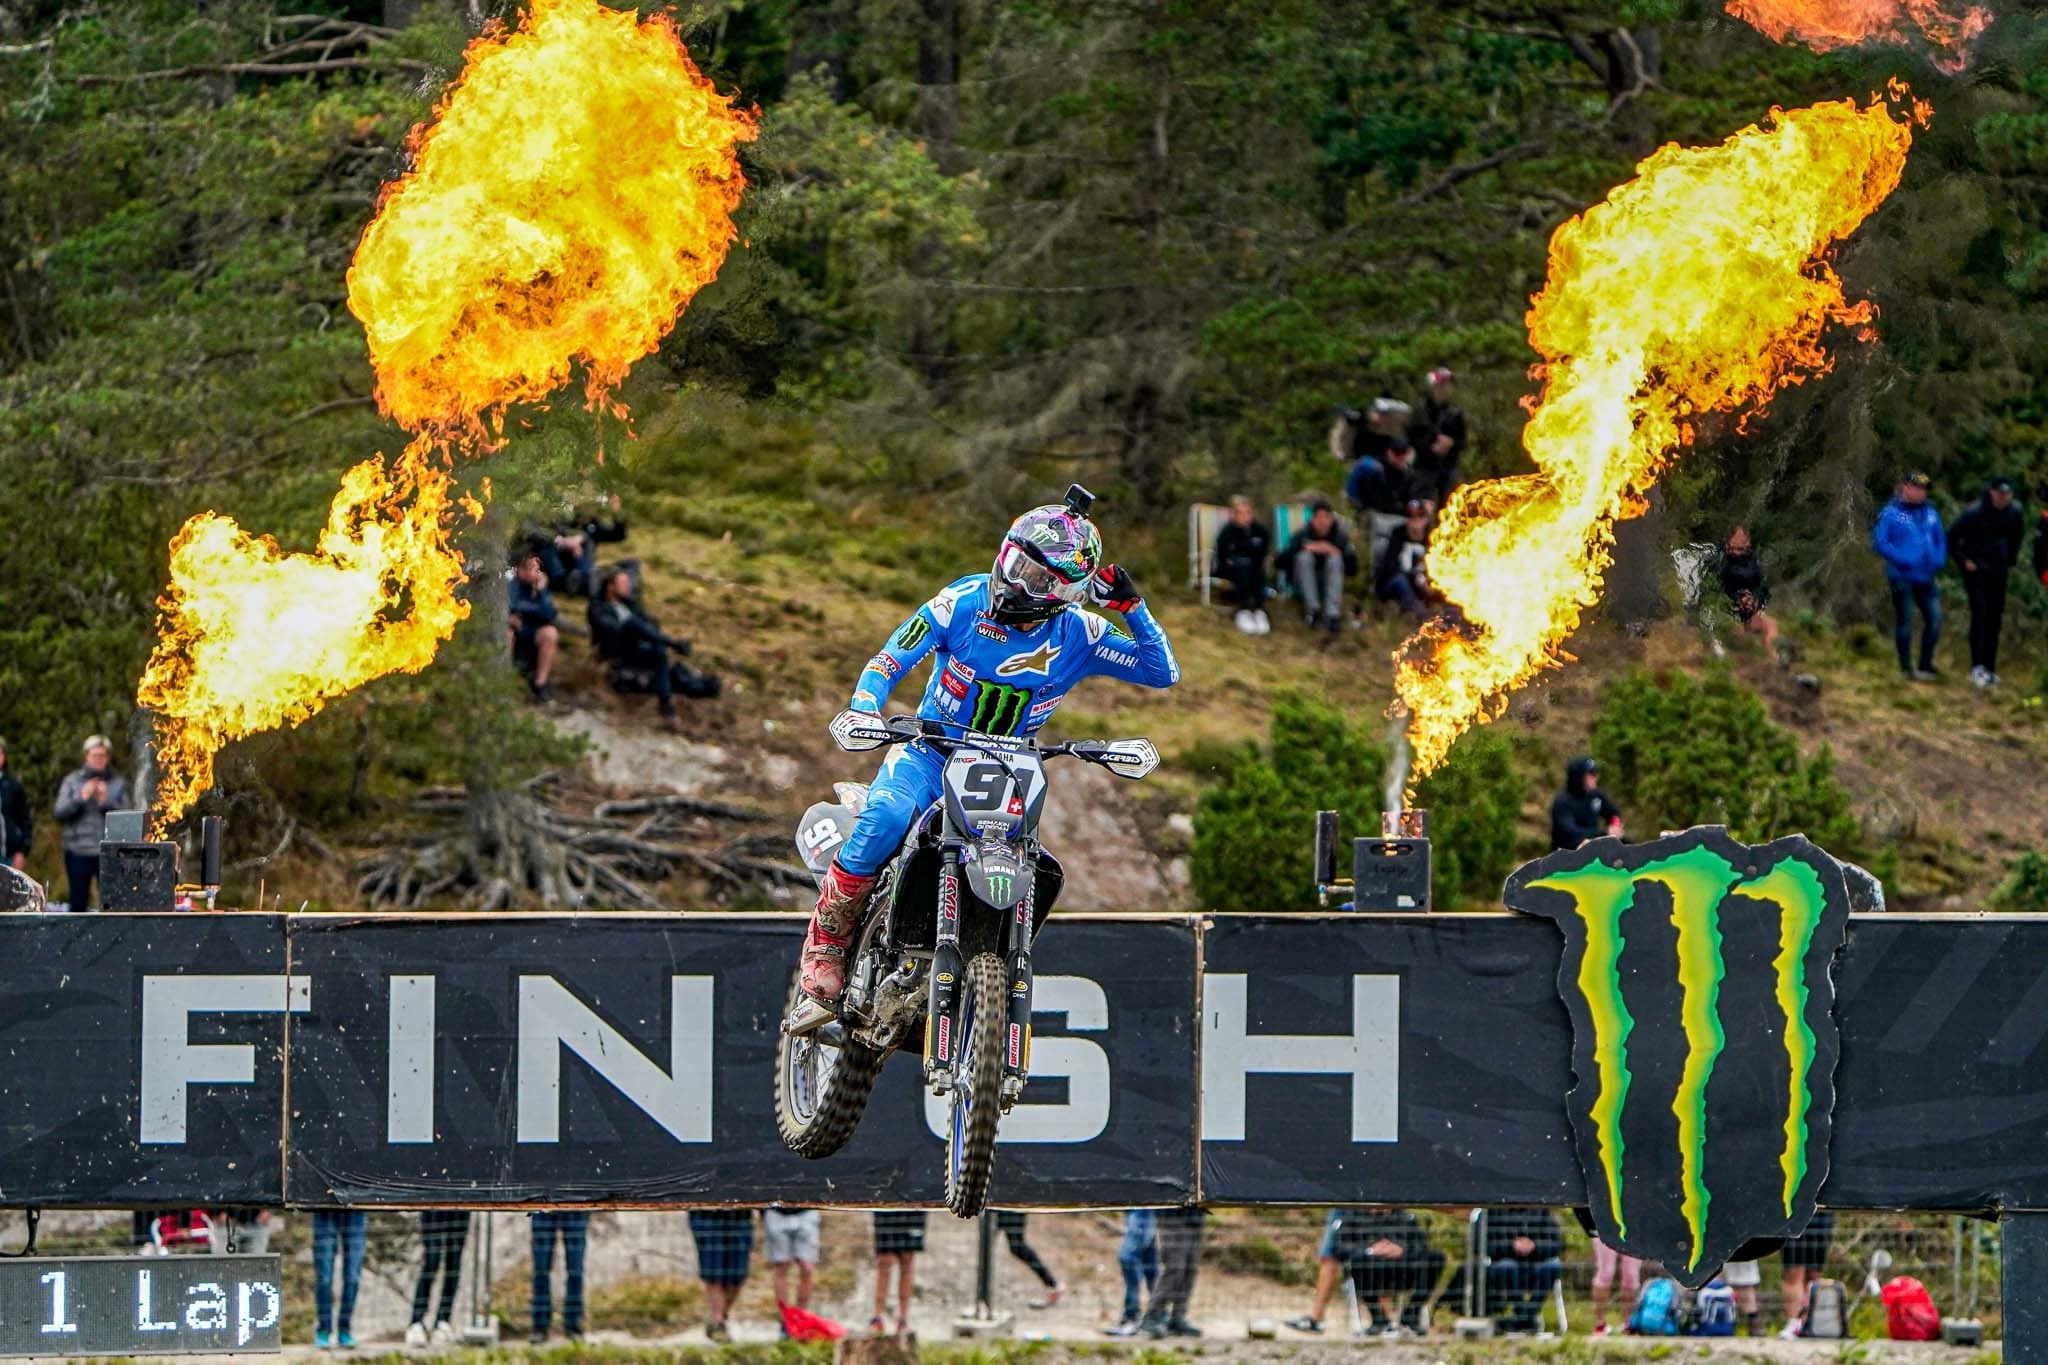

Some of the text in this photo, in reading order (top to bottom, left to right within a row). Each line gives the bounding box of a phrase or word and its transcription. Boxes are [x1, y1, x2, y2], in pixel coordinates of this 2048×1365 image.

[978, 627, 1008, 643] WILVO
[850, 731, 891, 739] ACERBIS
[960, 763, 1035, 811] 91
[804, 818, 843, 852] 91
[984, 865, 1016, 876] YAMAHA
[140, 973, 1400, 1144] FINSH
[939, 1017, 948, 1061] BRAKING
[1010, 1024, 1019, 1066] BRAKING
[41, 1269, 280, 1346] 1 Lap
